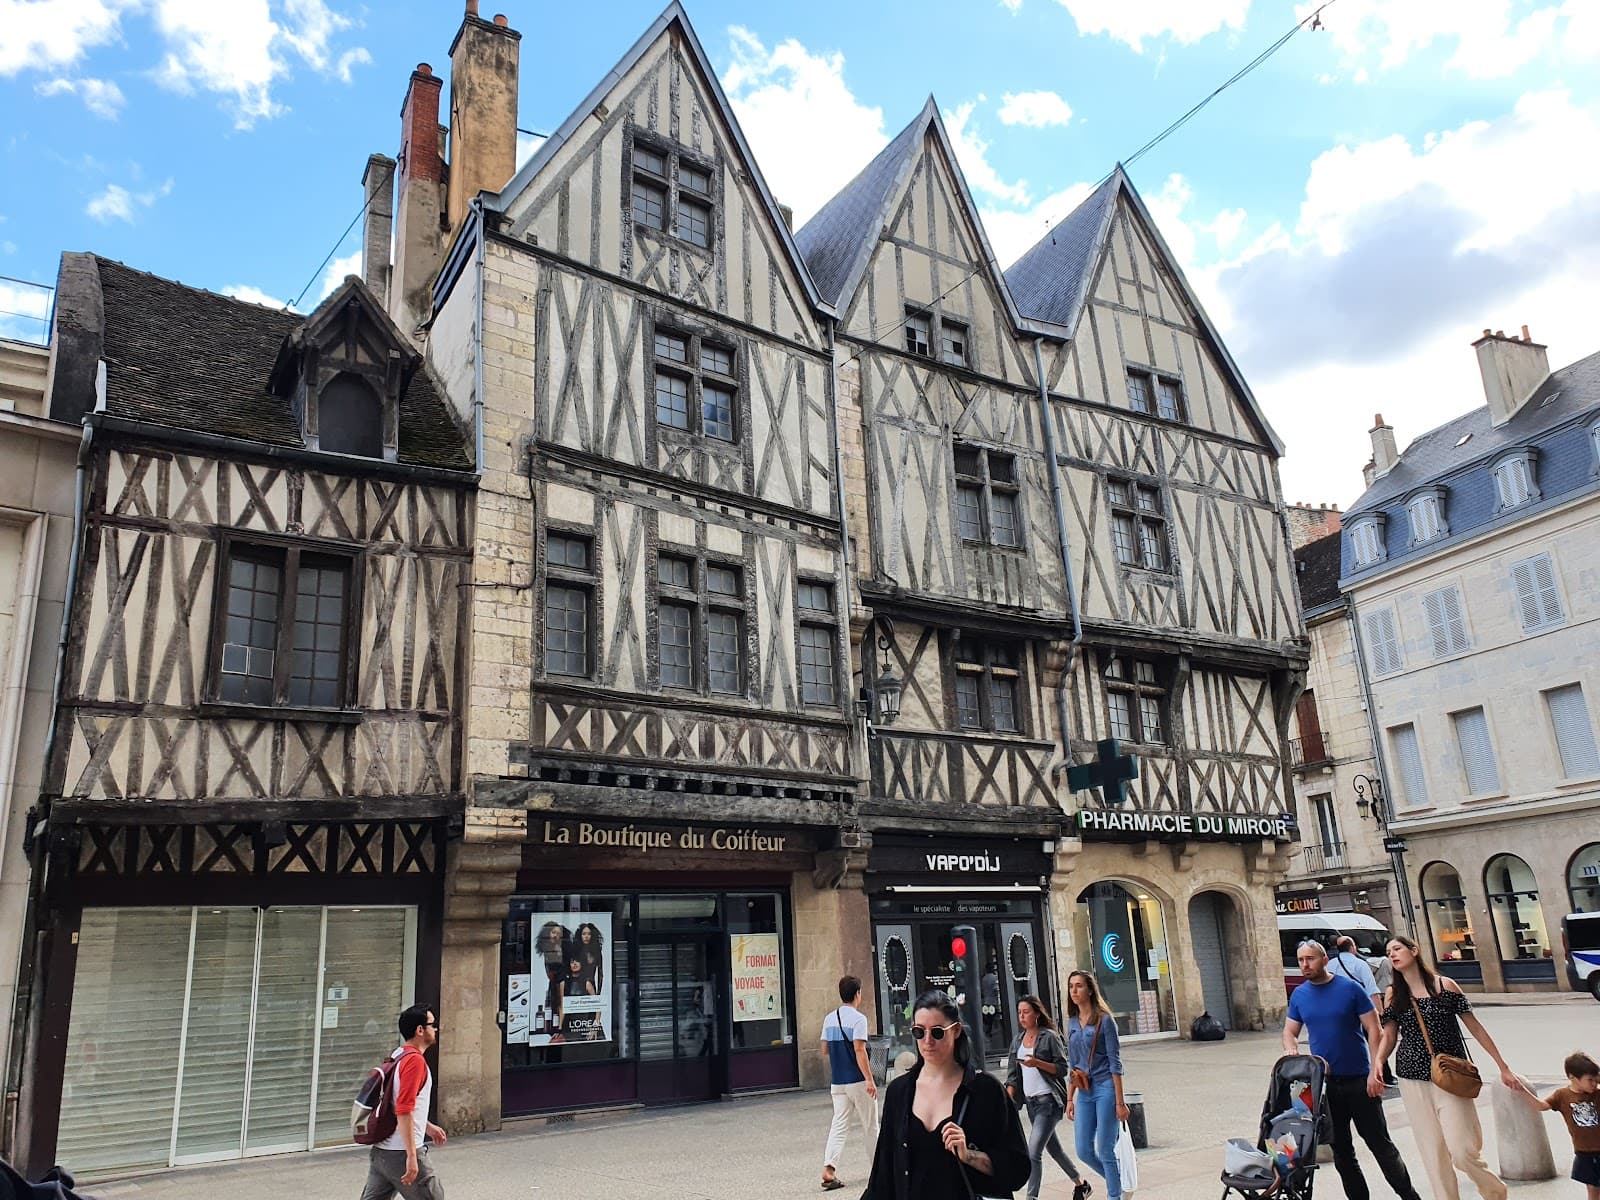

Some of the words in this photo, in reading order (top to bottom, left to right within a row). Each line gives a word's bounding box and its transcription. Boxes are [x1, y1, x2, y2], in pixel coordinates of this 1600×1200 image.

[1081, 810, 1192, 833] PHARMACIE
[1199, 817, 1223, 834] DU
[1229, 818, 1287, 836] MIROIR
[544, 821, 570, 844] La
[579, 822, 672, 852] Boutique
[680, 827, 705, 849] du
[711, 828, 786, 851] Coiffeur
[913, 904, 920, 912] le
[957, 904, 968, 912] des
[969, 905, 997, 913] vapoteurs
[745, 955, 777, 968] FORMAT
[734, 976, 765, 990] VOYAGE
